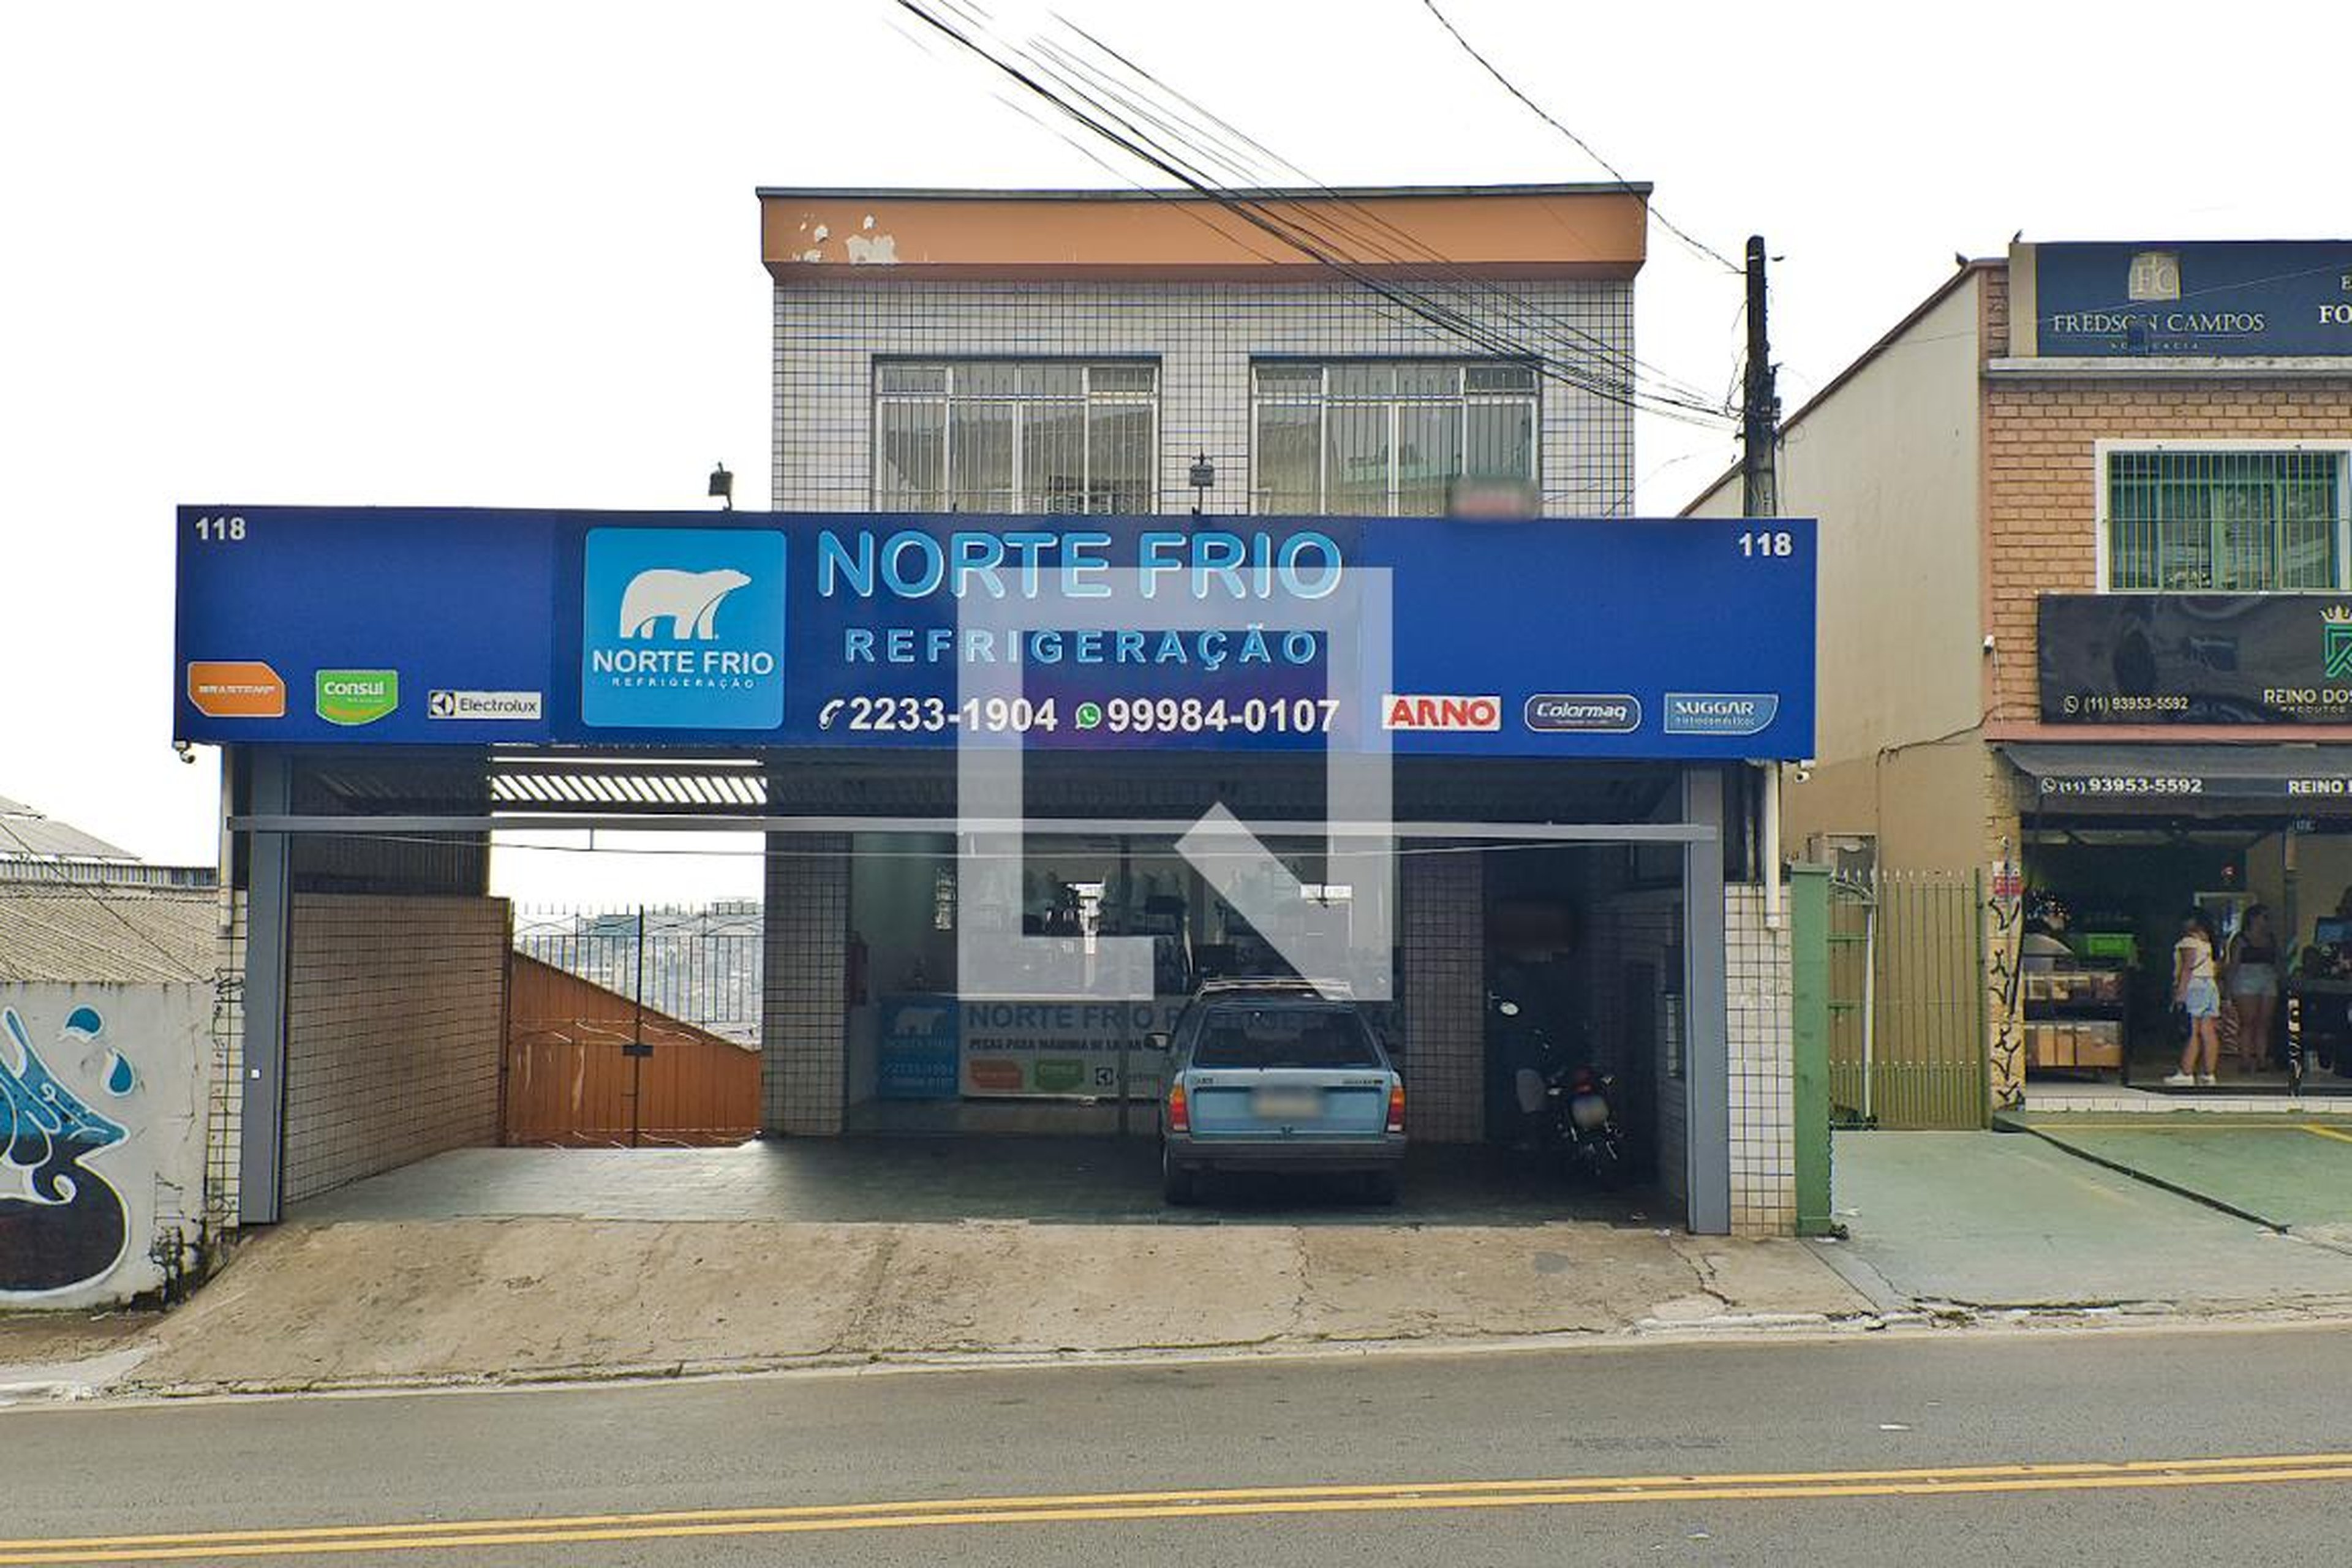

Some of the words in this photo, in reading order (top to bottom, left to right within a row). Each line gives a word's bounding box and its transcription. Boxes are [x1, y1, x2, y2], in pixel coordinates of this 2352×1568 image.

[2167, 313, 2265, 332] CAMPOS
[195, 518, 246, 540] 118
[1738, 532, 1792, 556] 118
[818, 530, 1112, 599] NORTE
[1138, 531, 1343, 600] FRIO
[844, 623, 1317, 671] REFRIGERAÇÃO
[592, 649, 695, 673] NORTE
[704, 651, 774, 674] FRIO
[324, 681, 385, 695] Consul
[612, 677, 754, 689] REFRIGERAÇÃO
[459, 698, 537, 714] Electrolux
[2084, 696, 2109, 714] (11)
[2113, 697, 2188, 710] 93953-5592
[2263, 689, 2317, 704] REINO
[849, 697, 1058, 733] 2233-1904
[1106, 698, 1340, 733] 99984-0107
[1387, 699, 1496, 727] ARNO
[1536, 702, 1627, 722] Colormaq
[1675, 701, 1755, 715] SUGGAR
[2060, 781, 2086, 794] (11)
[2089, 777, 2203, 793] 93953-5592
[2288, 780, 2344, 793] REINO
[968, 1005, 1074, 1029] NORTE
[1082, 1005, 1154, 1030] FRO
